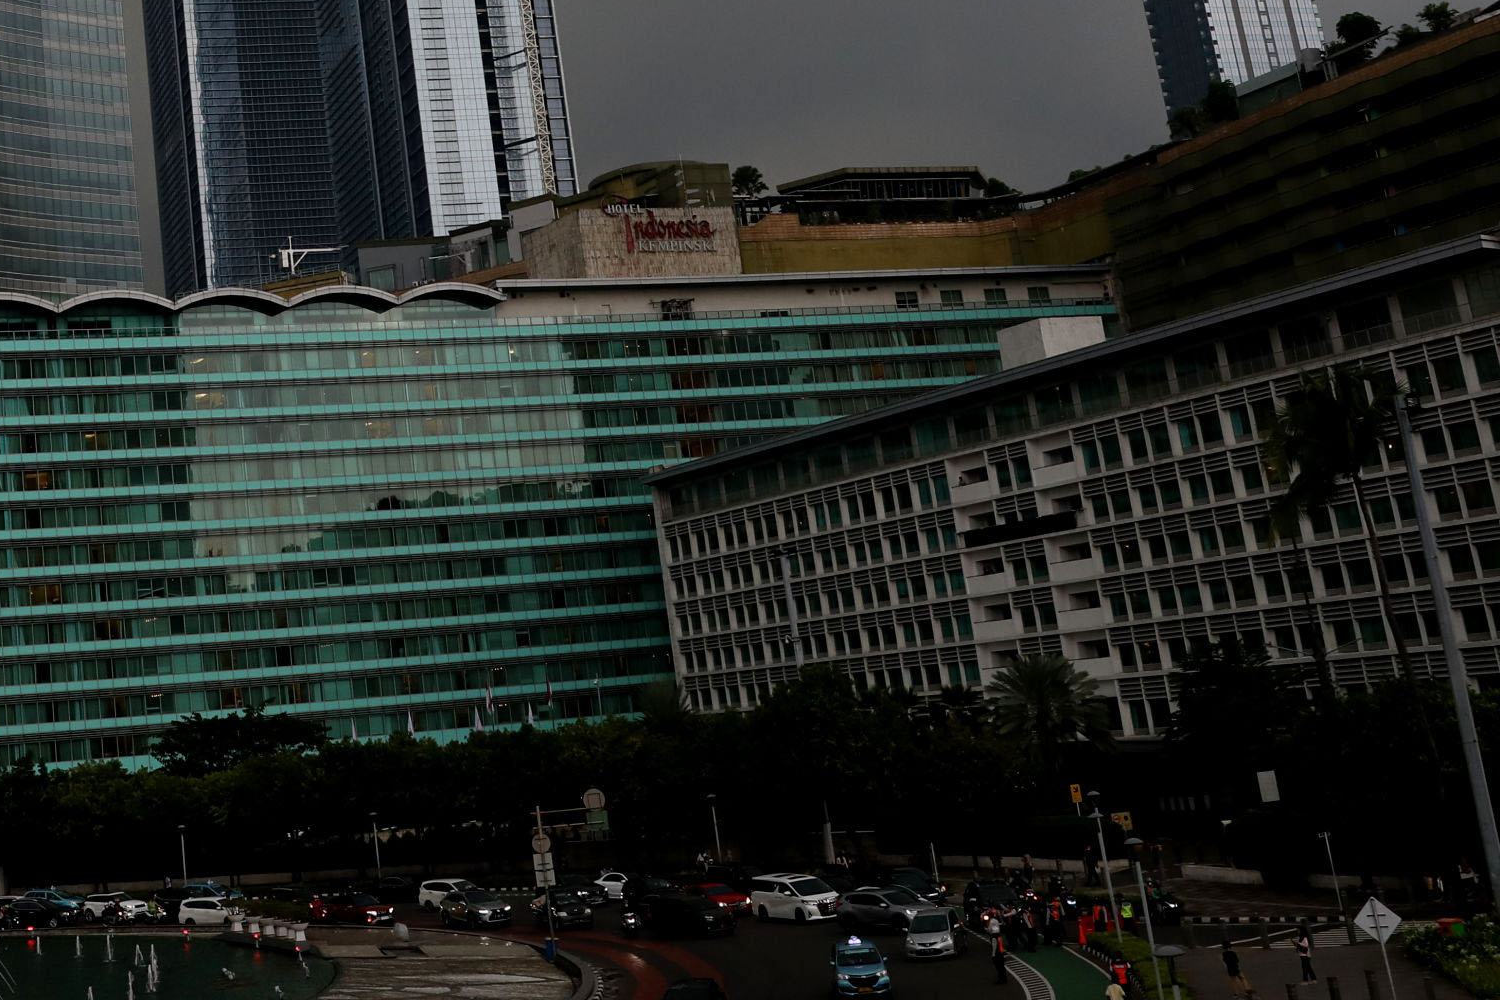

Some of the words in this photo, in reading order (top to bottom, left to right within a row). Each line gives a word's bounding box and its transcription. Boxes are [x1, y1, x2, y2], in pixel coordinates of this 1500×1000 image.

[606, 203, 644, 214] HOTEL
[623, 208, 717, 254] Indonesia
[637, 240, 716, 252] KEMPINSKI
